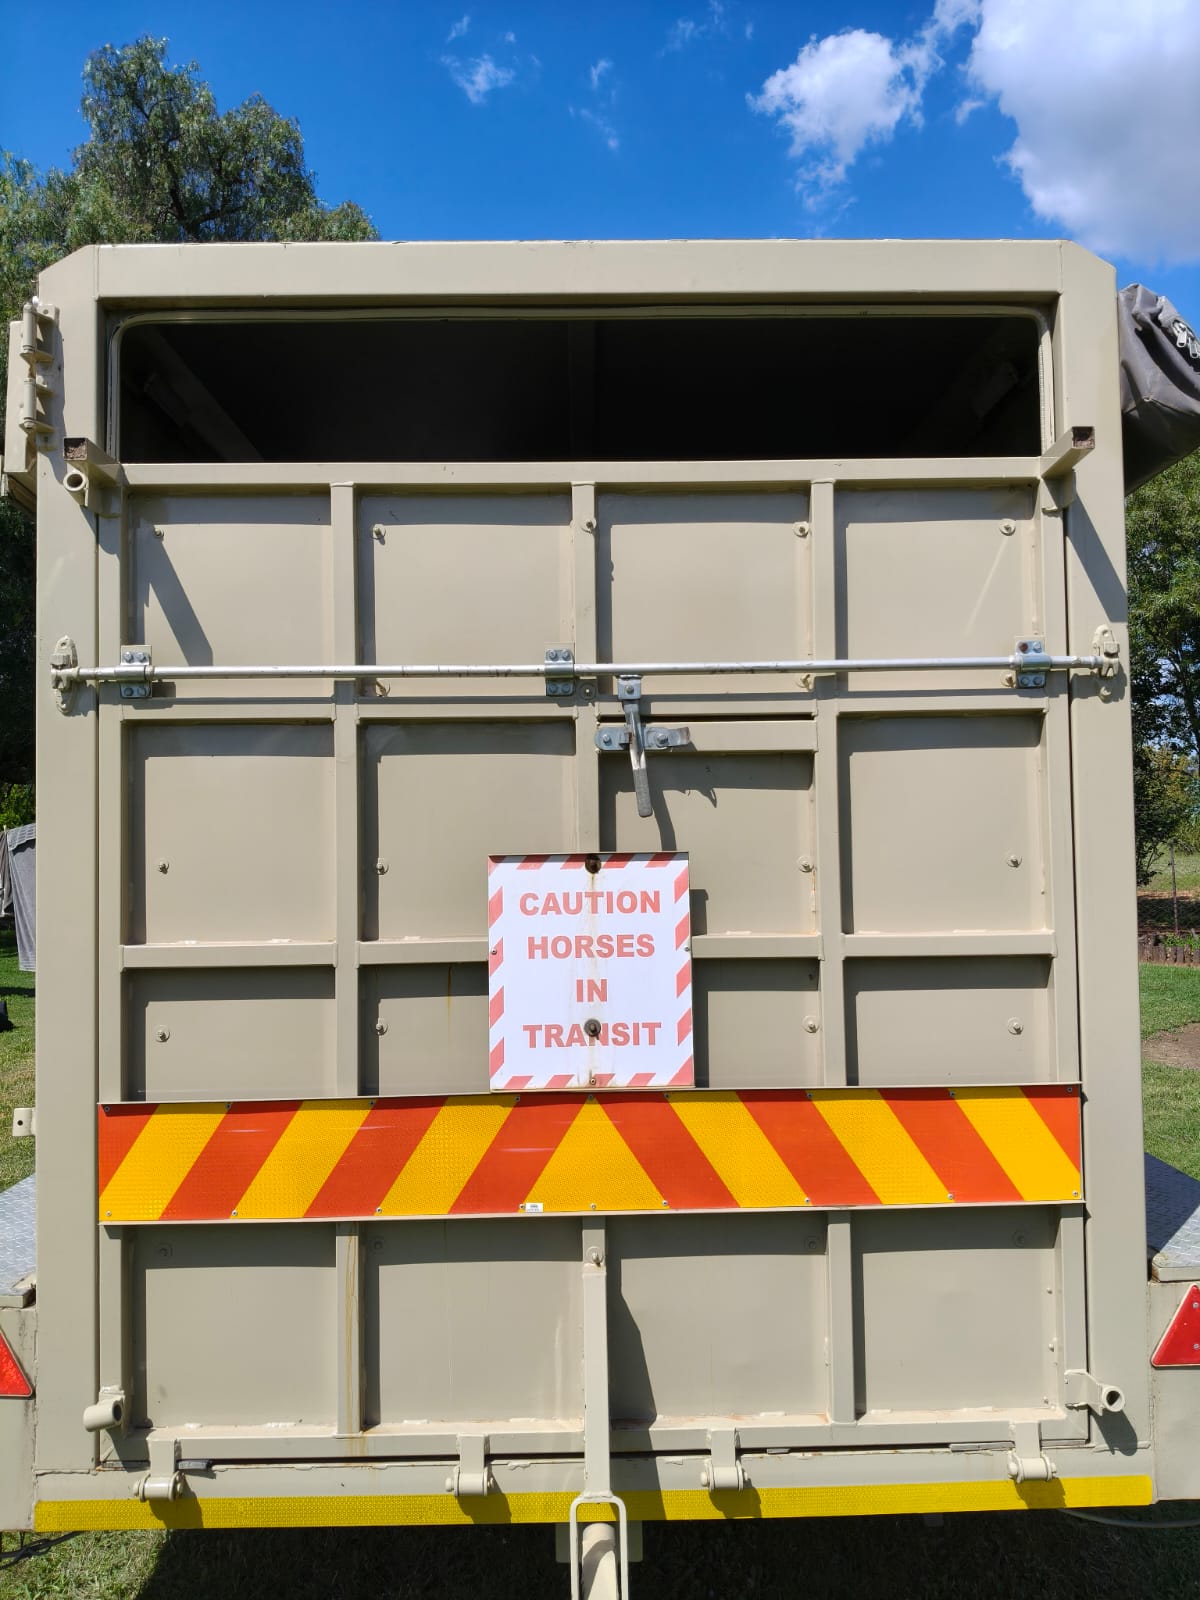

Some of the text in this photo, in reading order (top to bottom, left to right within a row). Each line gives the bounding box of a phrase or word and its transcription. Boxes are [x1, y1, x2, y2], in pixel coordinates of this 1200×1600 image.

[519, 890, 661, 916] CAUTION
[527, 933, 656, 960] HORSES
[576, 978, 608, 1003] IN
[522, 1022, 662, 1049] TRANSIT
